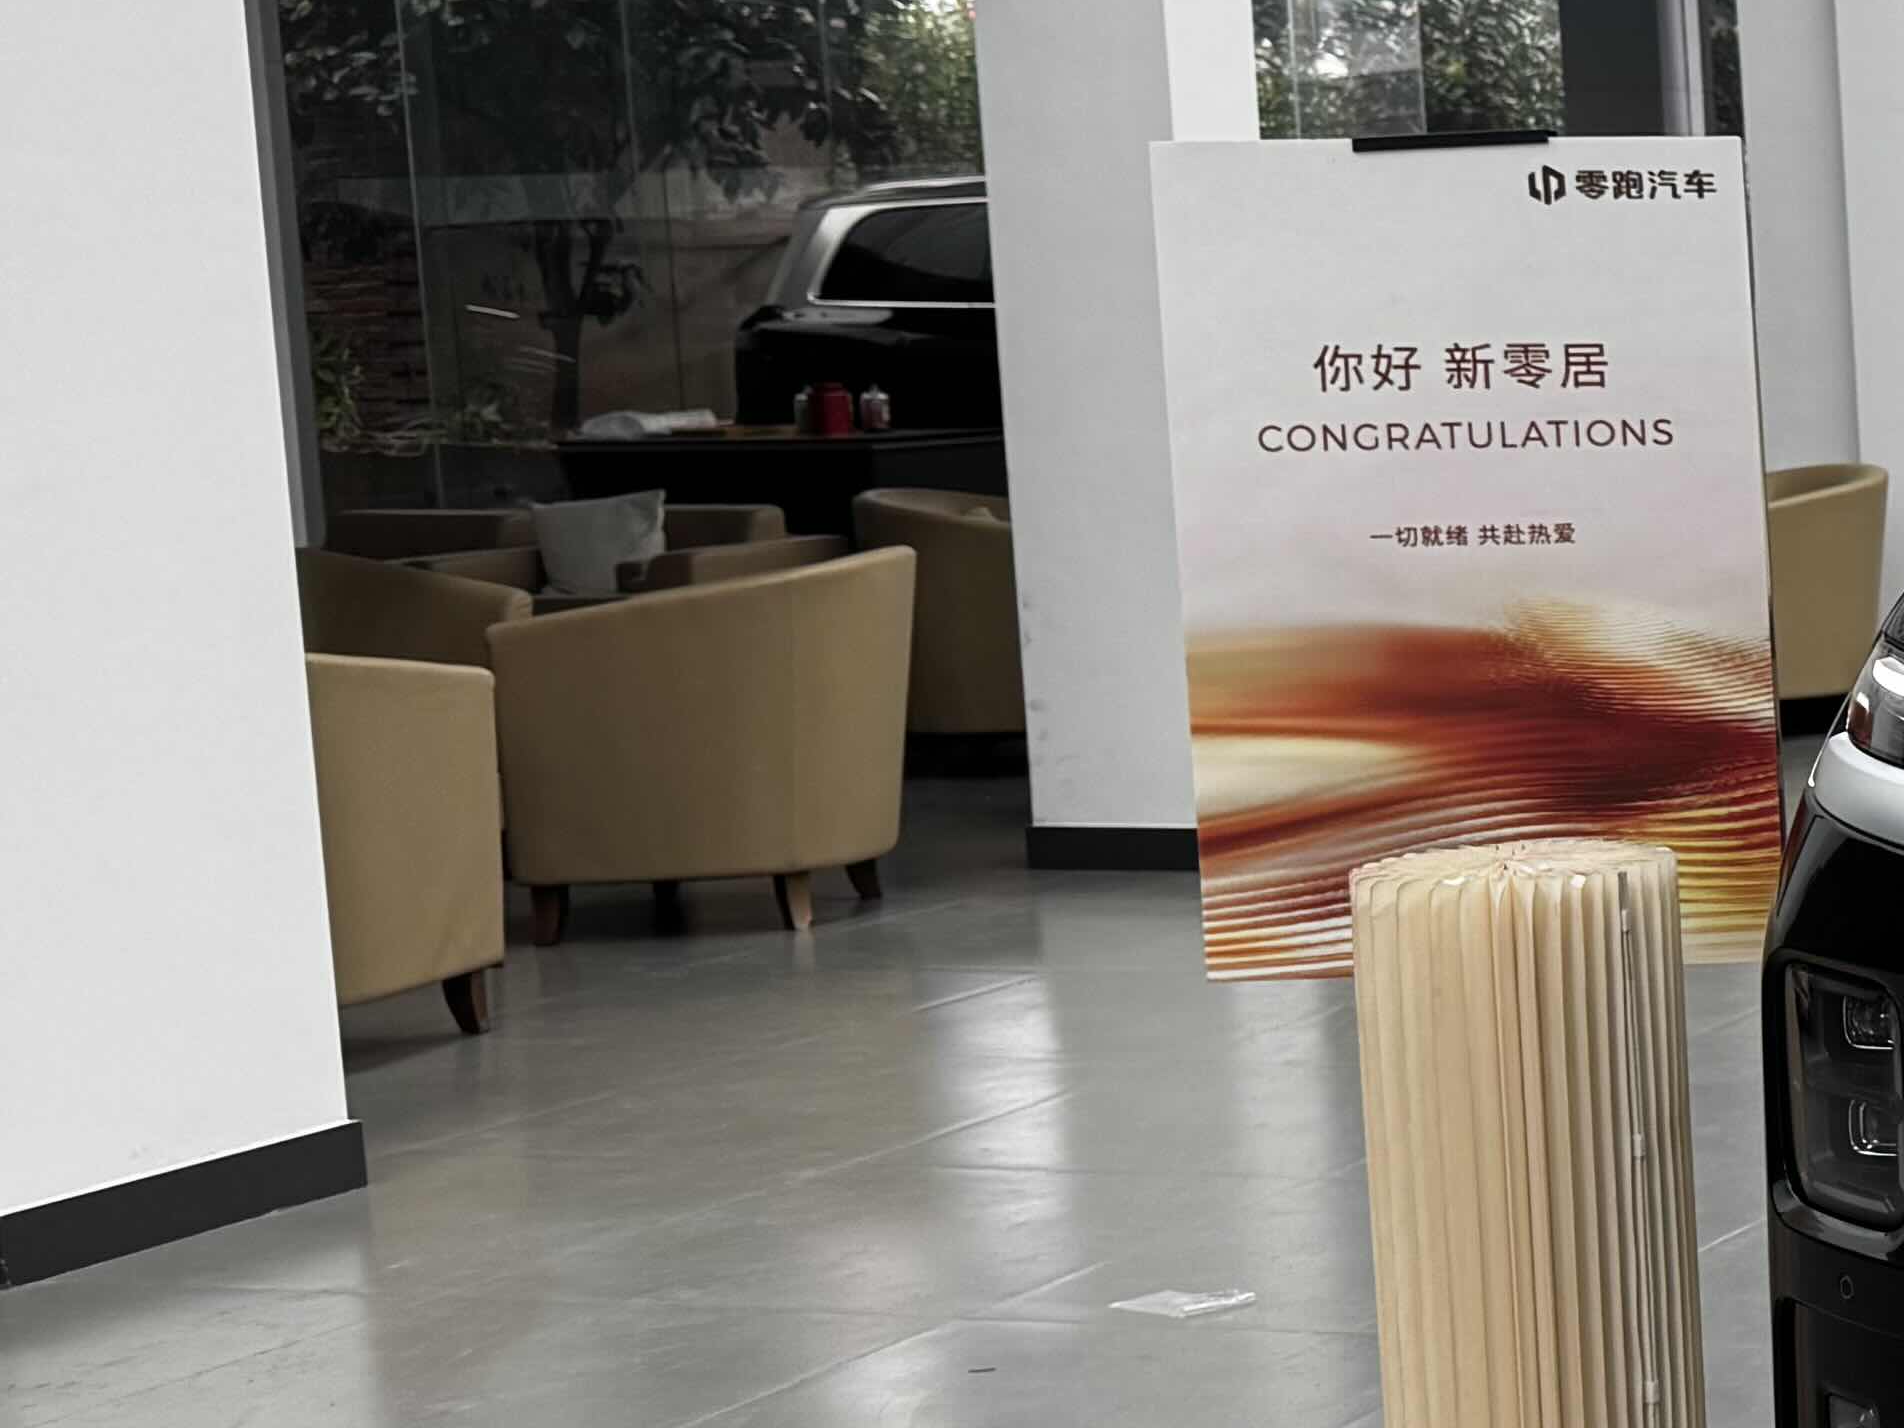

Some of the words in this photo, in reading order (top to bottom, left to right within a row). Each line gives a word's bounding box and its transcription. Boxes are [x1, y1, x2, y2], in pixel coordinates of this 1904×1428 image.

[1575, 169, 1718, 200] 零跑汽车
[1313, 343, 1422, 393] 你好
[1444, 342, 1610, 390] 新零居
[1257, 417, 1675, 454] CONGRATULATIONS
[1369, 524, 1469, 548] 一切就绪
[1477, 522, 1577, 547] 共赴热爱
